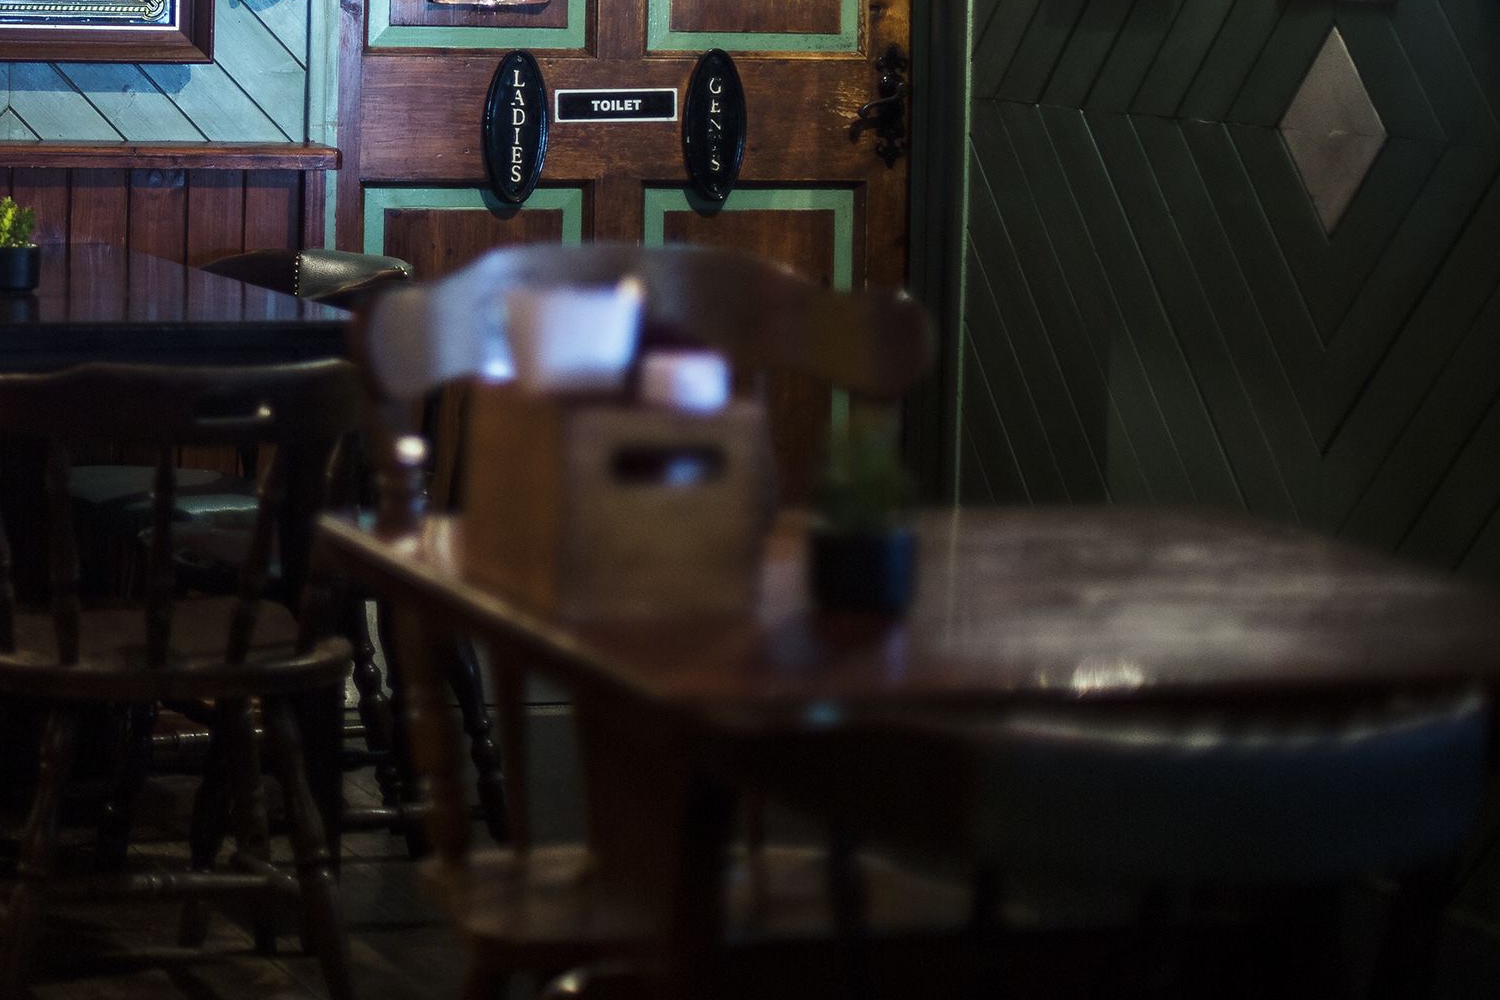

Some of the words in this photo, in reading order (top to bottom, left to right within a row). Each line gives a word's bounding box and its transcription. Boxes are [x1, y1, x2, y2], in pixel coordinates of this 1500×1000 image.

[510, 69, 526, 183] LADIES
[591, 99, 642, 112] TOILET
[708, 77, 722, 171] GENS
